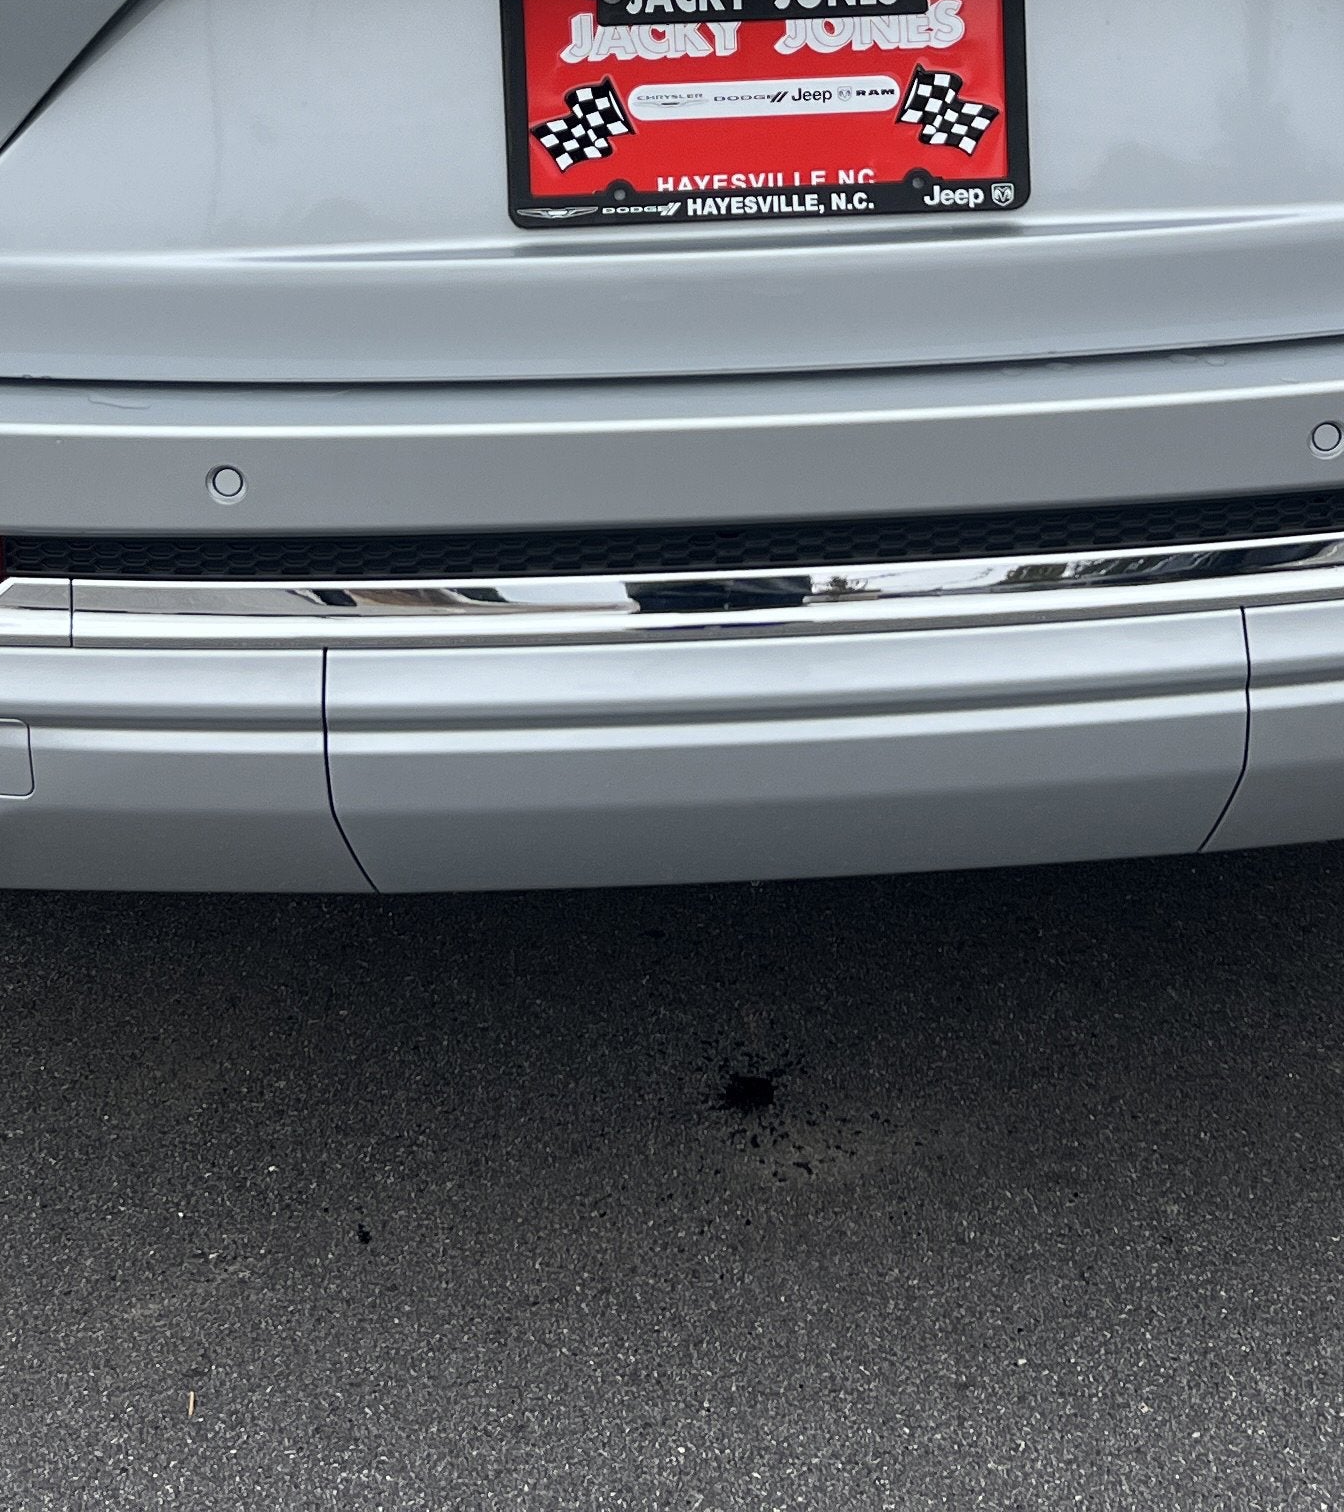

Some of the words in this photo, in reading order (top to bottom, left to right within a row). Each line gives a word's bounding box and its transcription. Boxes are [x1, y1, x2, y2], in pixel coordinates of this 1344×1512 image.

[560, 13, 742, 64] JACKY
[636, 93, 704, 101] CHRYSLER
[791, 88, 833, 103] Jeep
[856, 88, 895, 97] RAM
[687, 193, 825, 216] HAYESVILLE,
[830, 192, 875, 211] N.C.
[924, 185, 985, 208] Jeep
